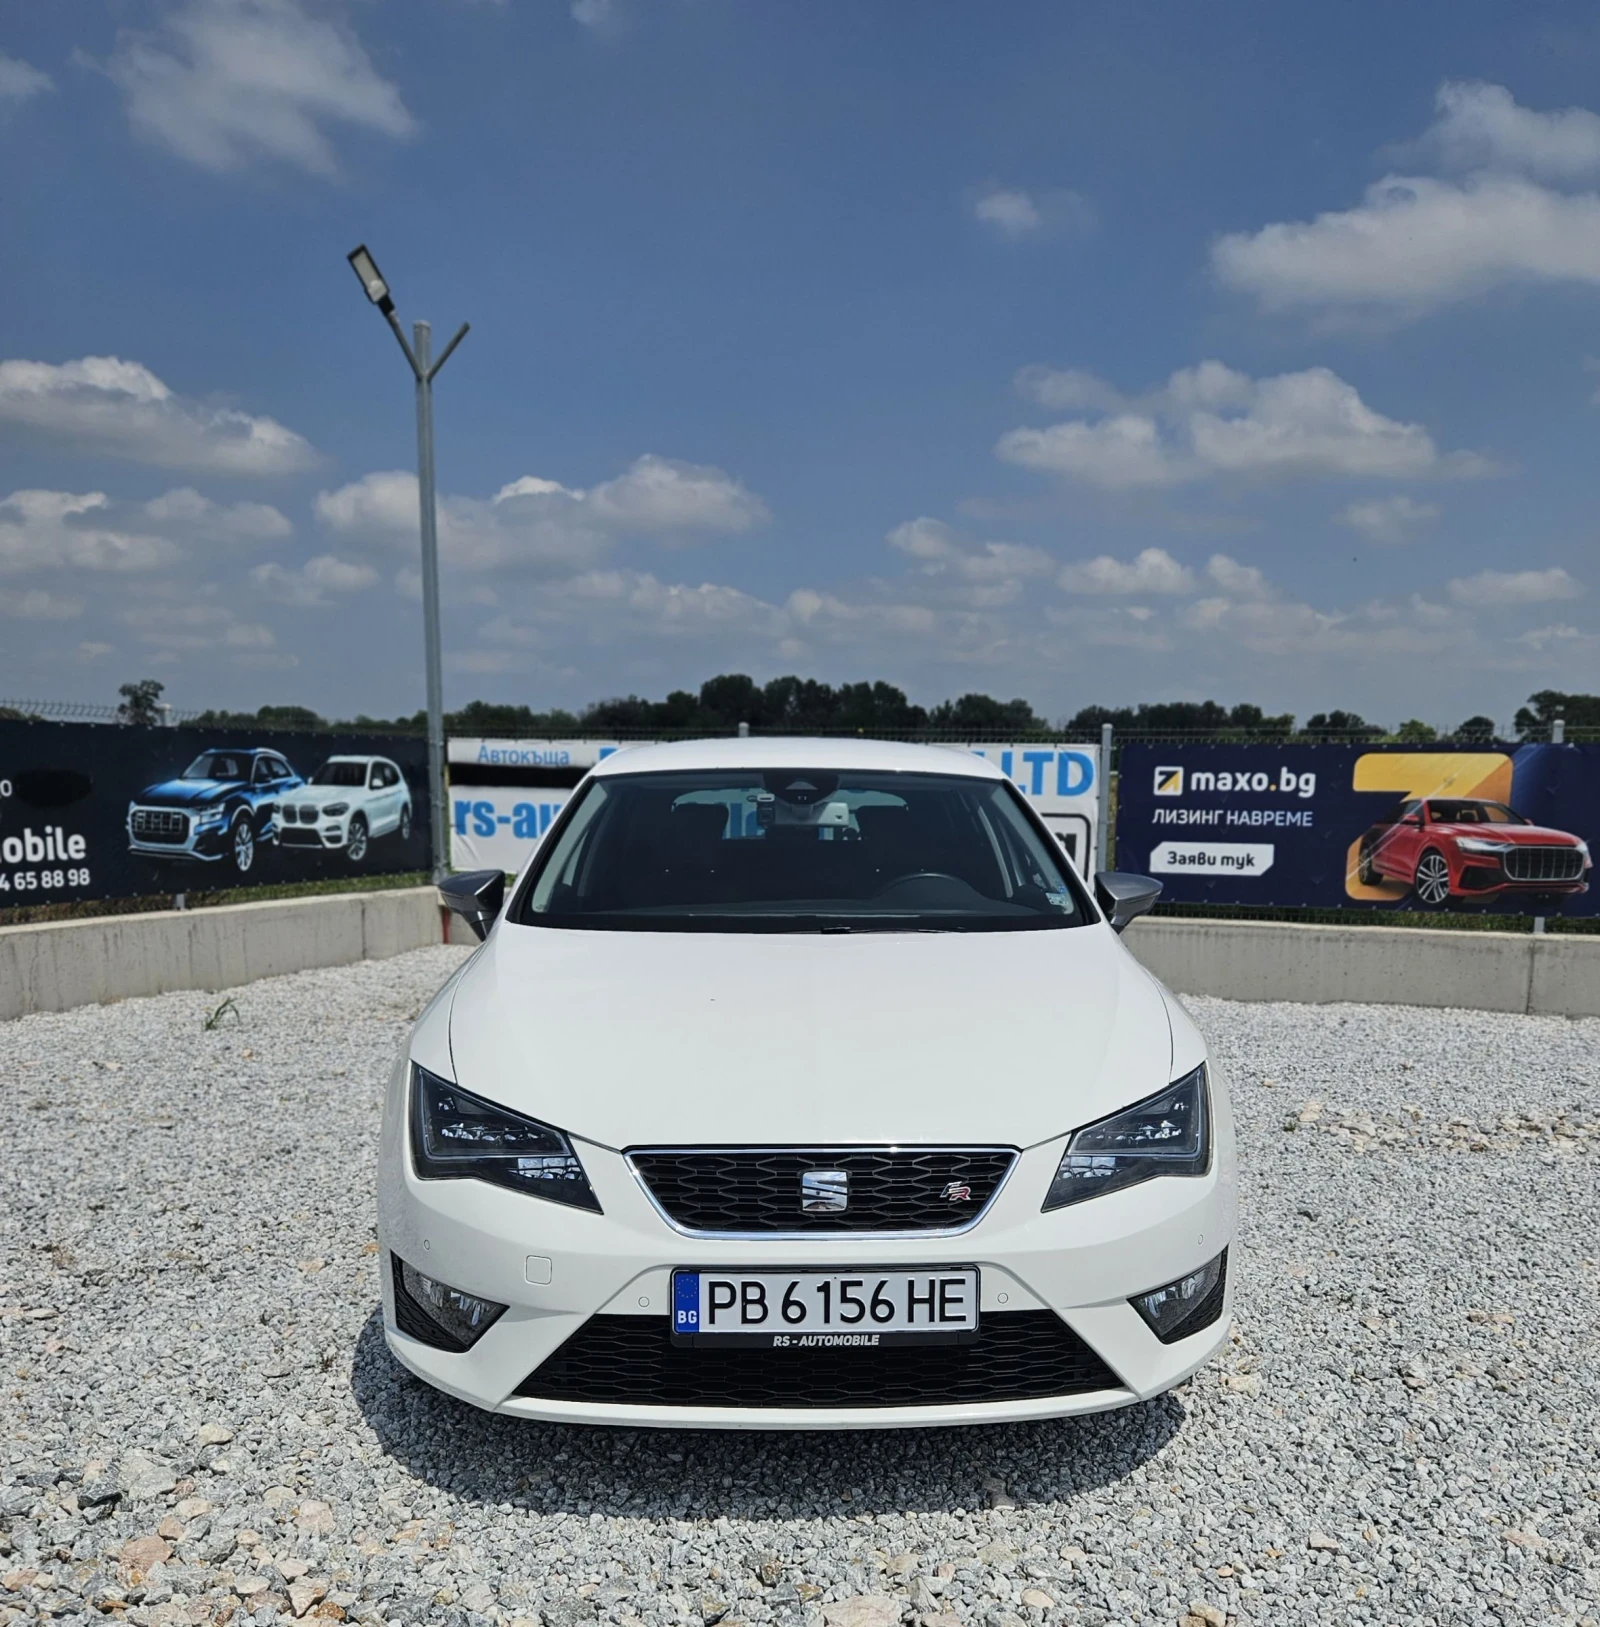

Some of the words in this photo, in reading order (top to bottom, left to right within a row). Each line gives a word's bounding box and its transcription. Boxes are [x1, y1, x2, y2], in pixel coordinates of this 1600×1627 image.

[477, 744, 570, 767] Автокъща
[1191, 766, 1316, 798] maxo.bg
[1152, 809, 1224, 824] ЛИЗИНГ
[1226, 810, 1314, 827] НАВРЕМЕ
[0, 825, 86, 863] obile
[1167, 851, 1216, 866] Заяви
[1220, 853, 1255, 870] тук
[14, 871, 38, 890] 65
[41, 869, 65, 888] 88
[67, 867, 91, 886] 98
[708, 1280, 769, 1325] PB
[781, 1280, 895, 1325] 6156
[907, 1278, 967, 1323] HE
[677, 1310, 698, 1324] BG
